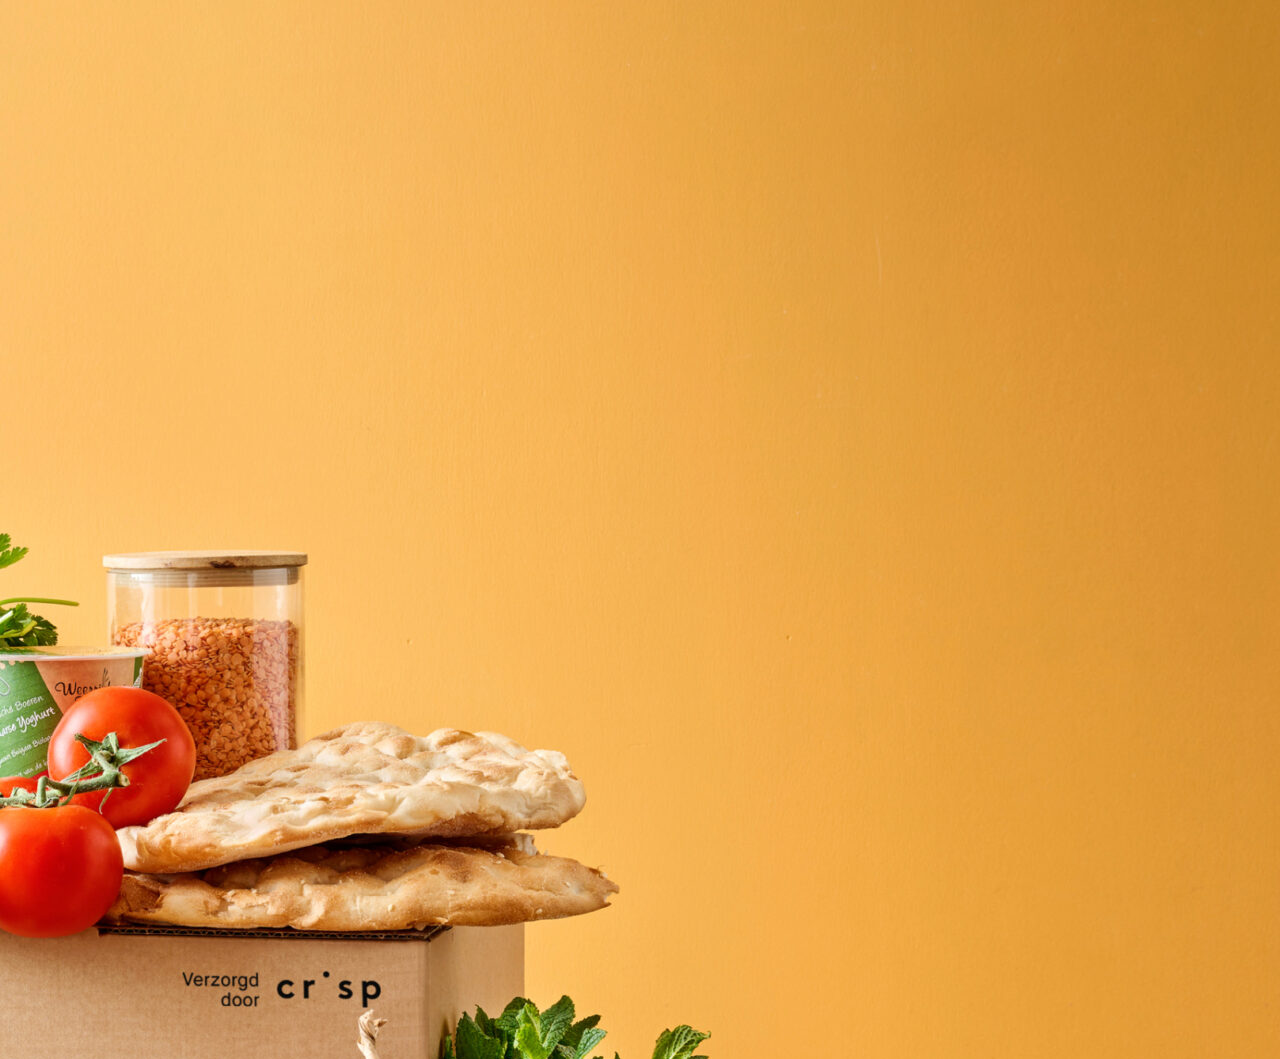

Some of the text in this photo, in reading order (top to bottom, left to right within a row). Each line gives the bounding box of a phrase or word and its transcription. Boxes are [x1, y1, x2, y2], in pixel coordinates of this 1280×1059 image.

[15, 695, 44, 711] Boeren
[16, 706, 56, 733] Yoghurt
[182, 971, 259, 991] Verzorgd
[221, 992, 260, 1007] door
